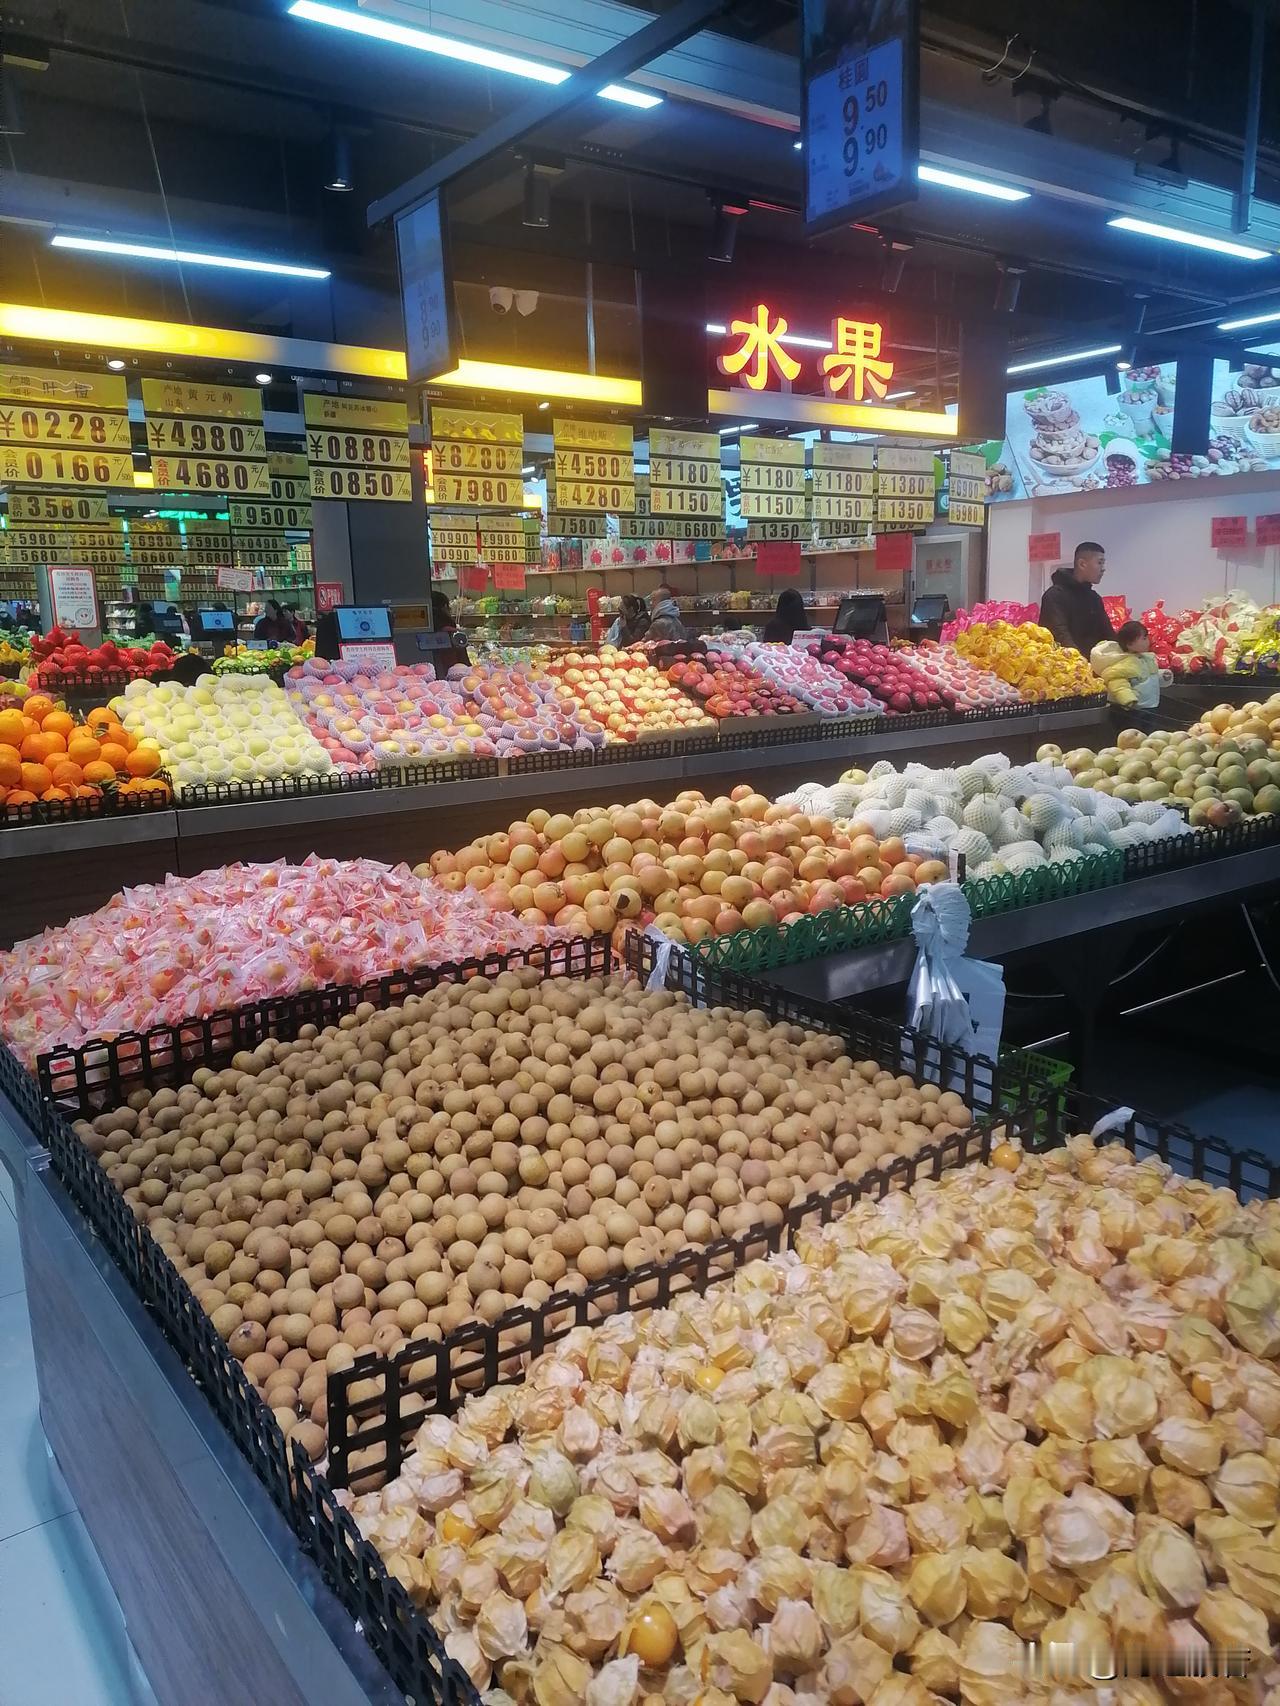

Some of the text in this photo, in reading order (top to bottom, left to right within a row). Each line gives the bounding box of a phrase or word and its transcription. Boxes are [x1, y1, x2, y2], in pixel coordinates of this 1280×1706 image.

[838, 57, 869, 89] 桂圆
[719, 304, 894, 400] 水果
[164, 384, 233, 403] 产地 黄元帅
[323, 399, 340, 409] 产地
[155, 458, 171, 487] 会员价
[313, 468, 326, 494] 会员价
